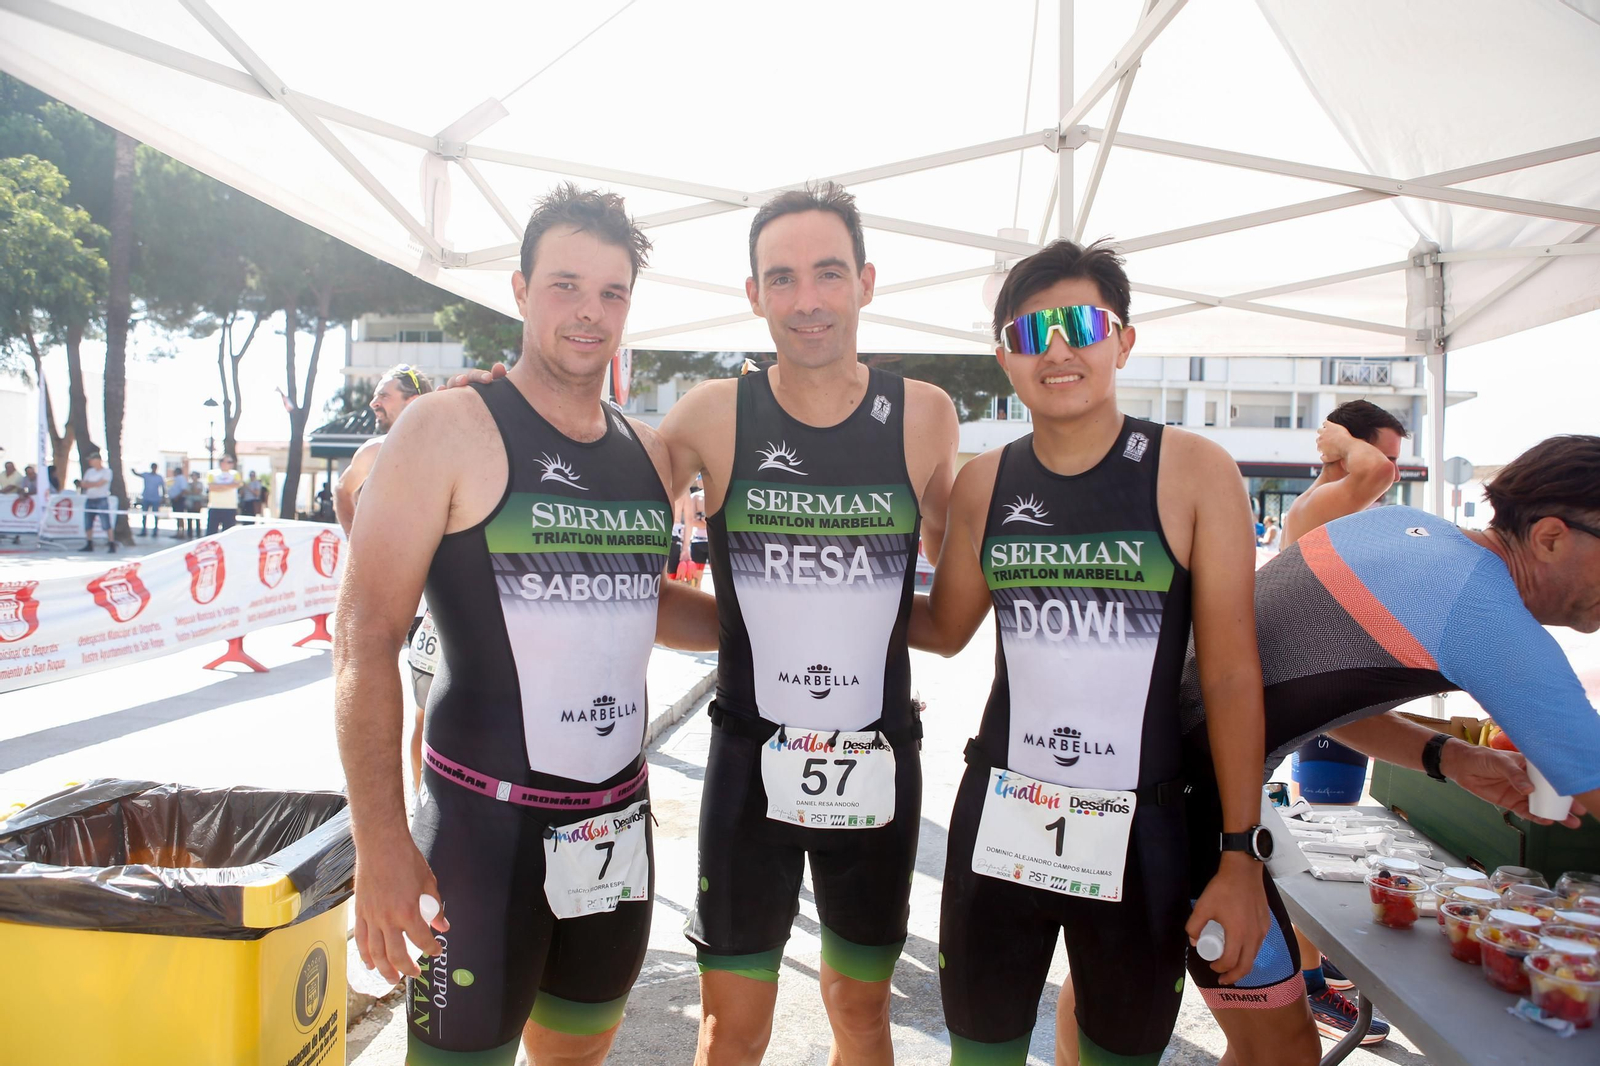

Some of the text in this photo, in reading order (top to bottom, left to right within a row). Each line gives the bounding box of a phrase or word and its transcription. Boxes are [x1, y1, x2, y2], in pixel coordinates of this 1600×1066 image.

[747, 487, 893, 515] SERMAN
[531, 502, 666, 533] SERMAN
[747, 514, 895, 528] TRIATLON MARBELLA
[532, 532, 668, 548] TRIATLON MARBELLA
[764, 543, 875, 585] RESA
[991, 541, 1145, 568] SERMAN
[993, 568, 1145, 583] TRIATLON MARBELLA
[1013, 598, 1126, 644] DOWI
[23, 646, 30, 657] de
[32, 643, 59, 657] Deportes
[417, 631, 437, 656] 86
[24, 664, 33, 676] de
[34, 661, 46, 674] San
[47, 659, 66, 672] Roque
[778, 671, 860, 686] MARBELLA
[561, 702, 638, 723] MARBELLA
[1023, 733, 1116, 756] MARBELLA
[427, 752, 487, 790] IRONMAN
[801, 758, 857, 796] 57
[522, 793, 591, 805] IRONMAN
[811, 814, 828, 822] PST
[1045, 816, 1066, 857] 1
[594, 841, 615, 881] 7
[986, 846, 1113, 877] DOMINIC ALEJANDRO CAMPOS MALLAMAS
[1029, 871, 1049, 883] PST
[433, 934, 448, 1009] GRUPO
[1219, 993, 1268, 1003] TAYMORY
[312, 1034, 318, 1050] de
[319, 1009, 338, 1042] Deportes
